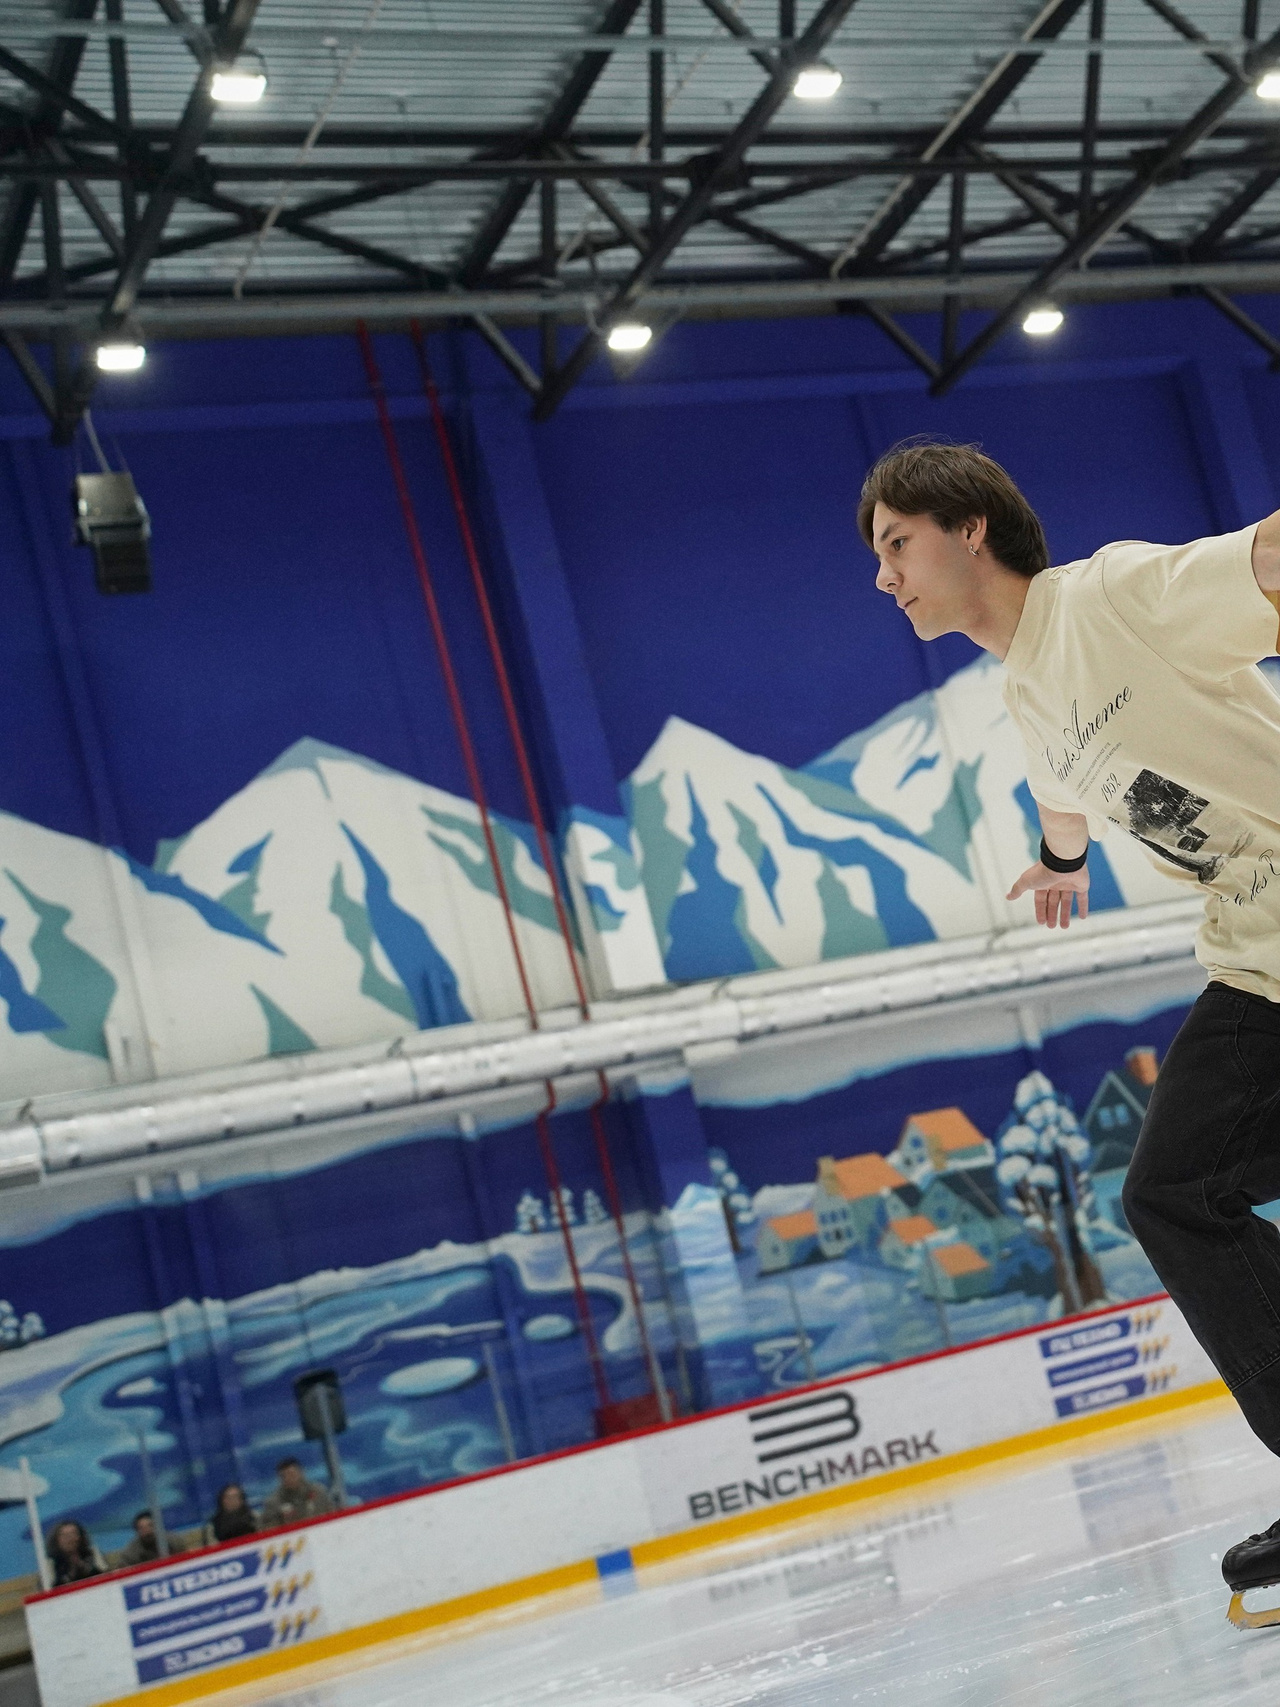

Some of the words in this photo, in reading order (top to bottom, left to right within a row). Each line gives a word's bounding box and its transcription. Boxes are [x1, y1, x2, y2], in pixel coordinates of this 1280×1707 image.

[1100, 772, 1122, 803] 1952
[1250, 869, 1268, 901] des
[687, 1430, 941, 1520] BENCHMARK
